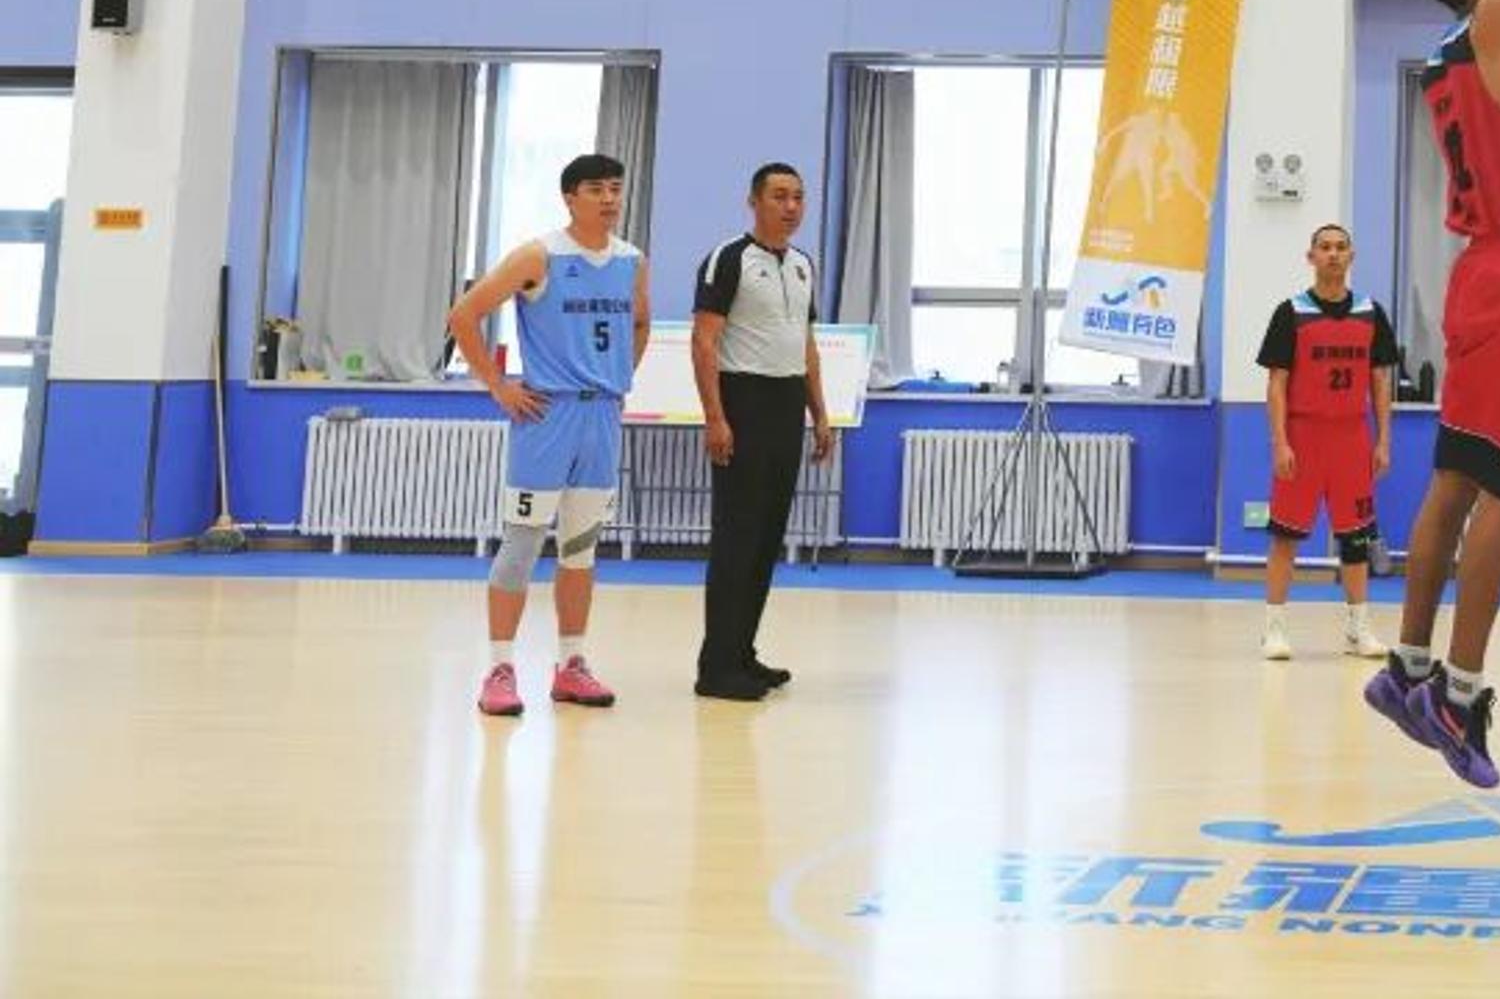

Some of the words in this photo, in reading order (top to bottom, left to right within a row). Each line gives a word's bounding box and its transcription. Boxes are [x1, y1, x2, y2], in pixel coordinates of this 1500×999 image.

[594, 321, 610, 352] 5
[1329, 367, 1352, 390] 23
[517, 493, 533, 516] 5
